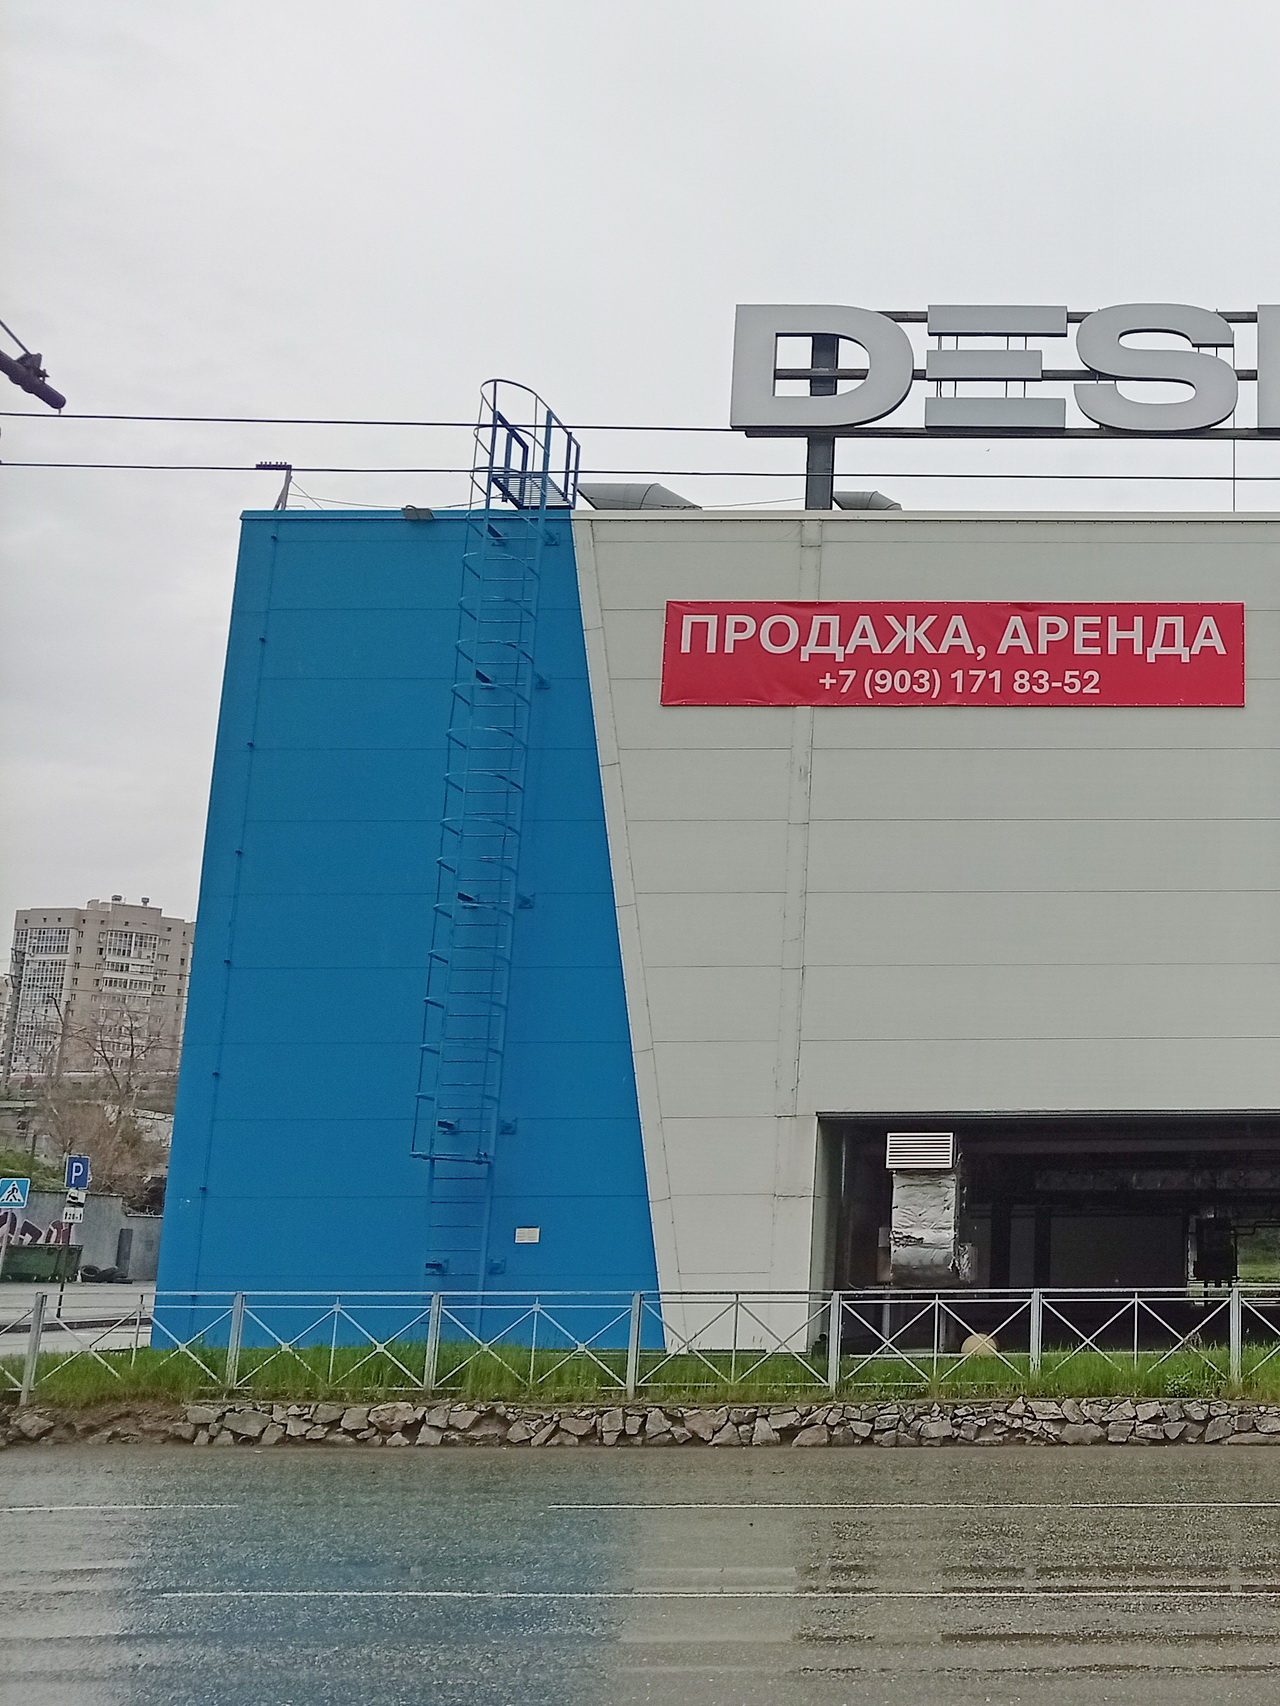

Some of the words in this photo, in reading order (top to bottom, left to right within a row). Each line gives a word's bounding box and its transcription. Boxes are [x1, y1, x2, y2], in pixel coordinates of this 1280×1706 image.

[680, 614, 986, 662] ПРОДАЖА,
[997, 615, 1227, 663] АРЕНДА
[819, 670, 857, 693] +7
[864, 669, 941, 698] (903)
[950, 670, 1001, 693] 171
[1013, 670, 1100, 694] 83-52
